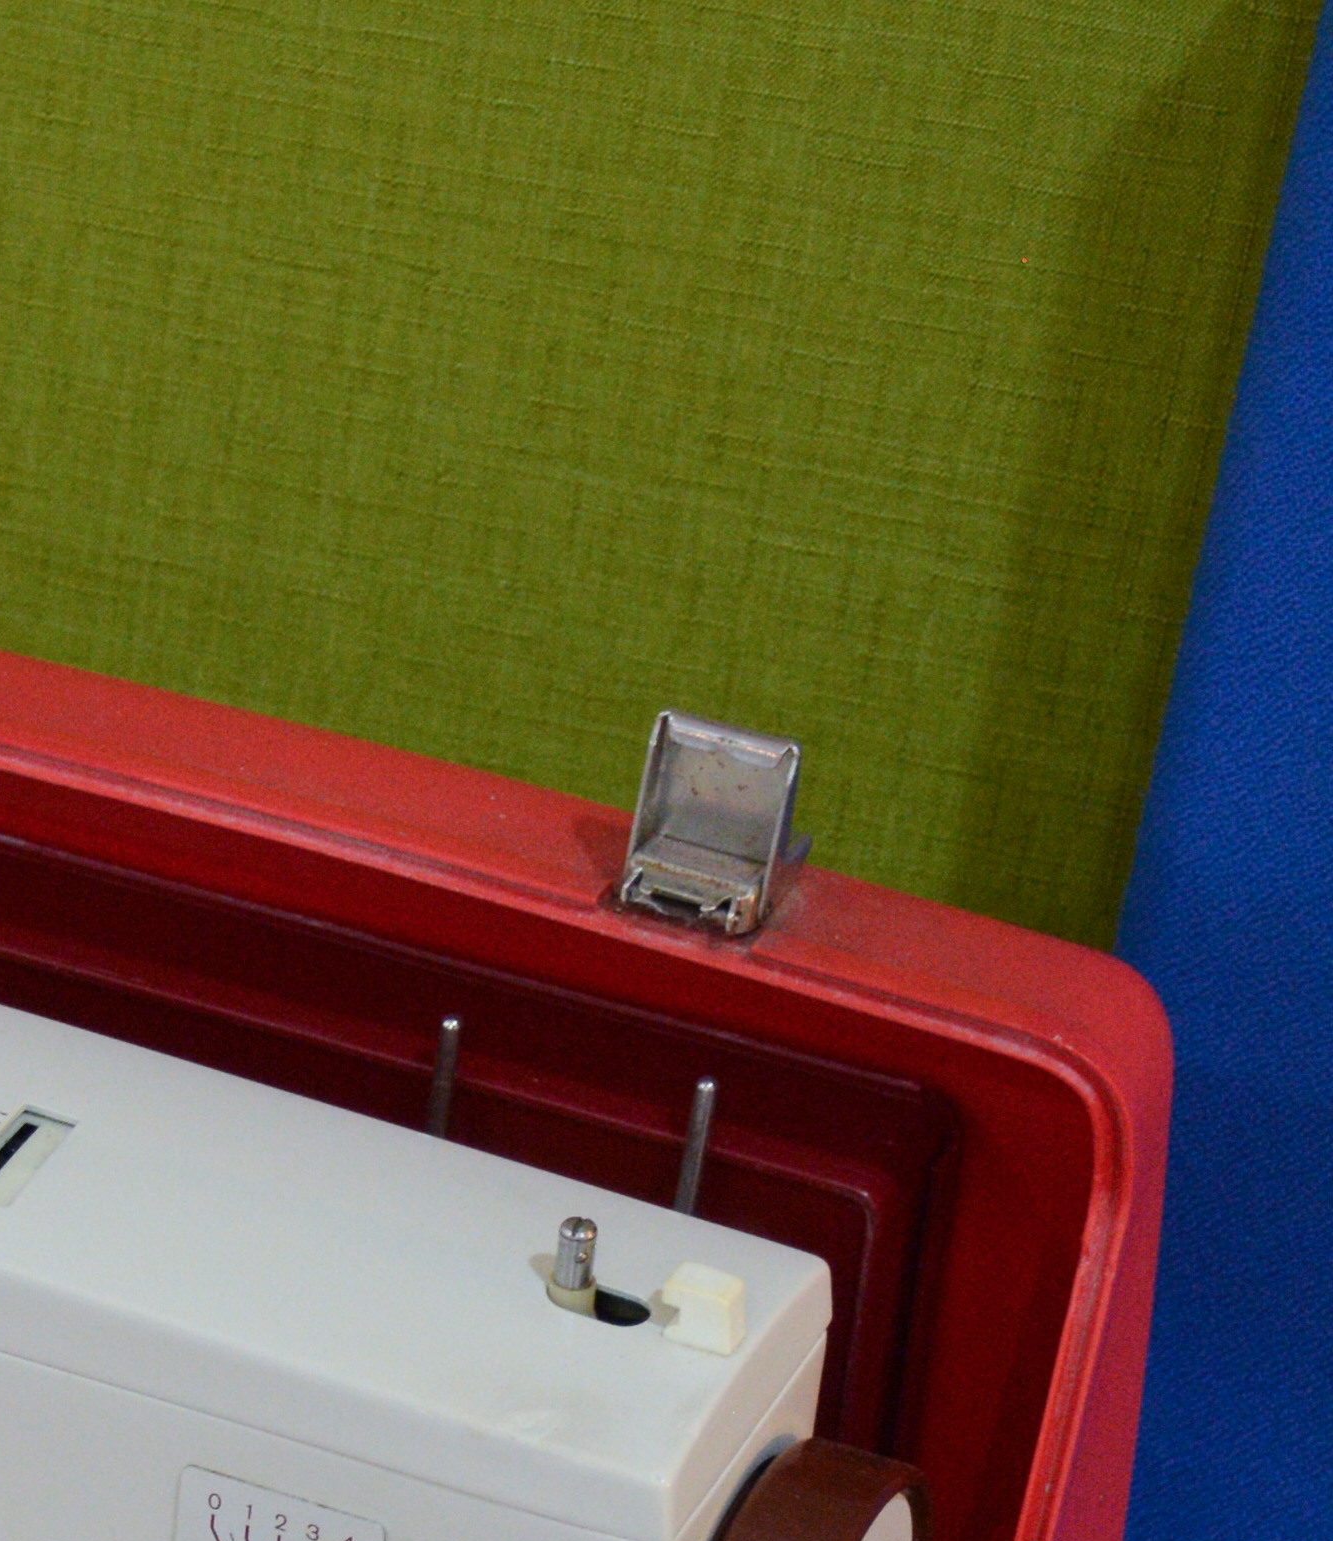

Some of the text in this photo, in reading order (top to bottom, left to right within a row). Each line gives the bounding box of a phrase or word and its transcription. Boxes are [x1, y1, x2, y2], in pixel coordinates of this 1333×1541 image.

[207, 1492, 223, 1511] 0
[245, 1503, 254, 1521] 1
[274, 1513, 288, 1532] 2
[305, 1523, 321, 1541] 3
